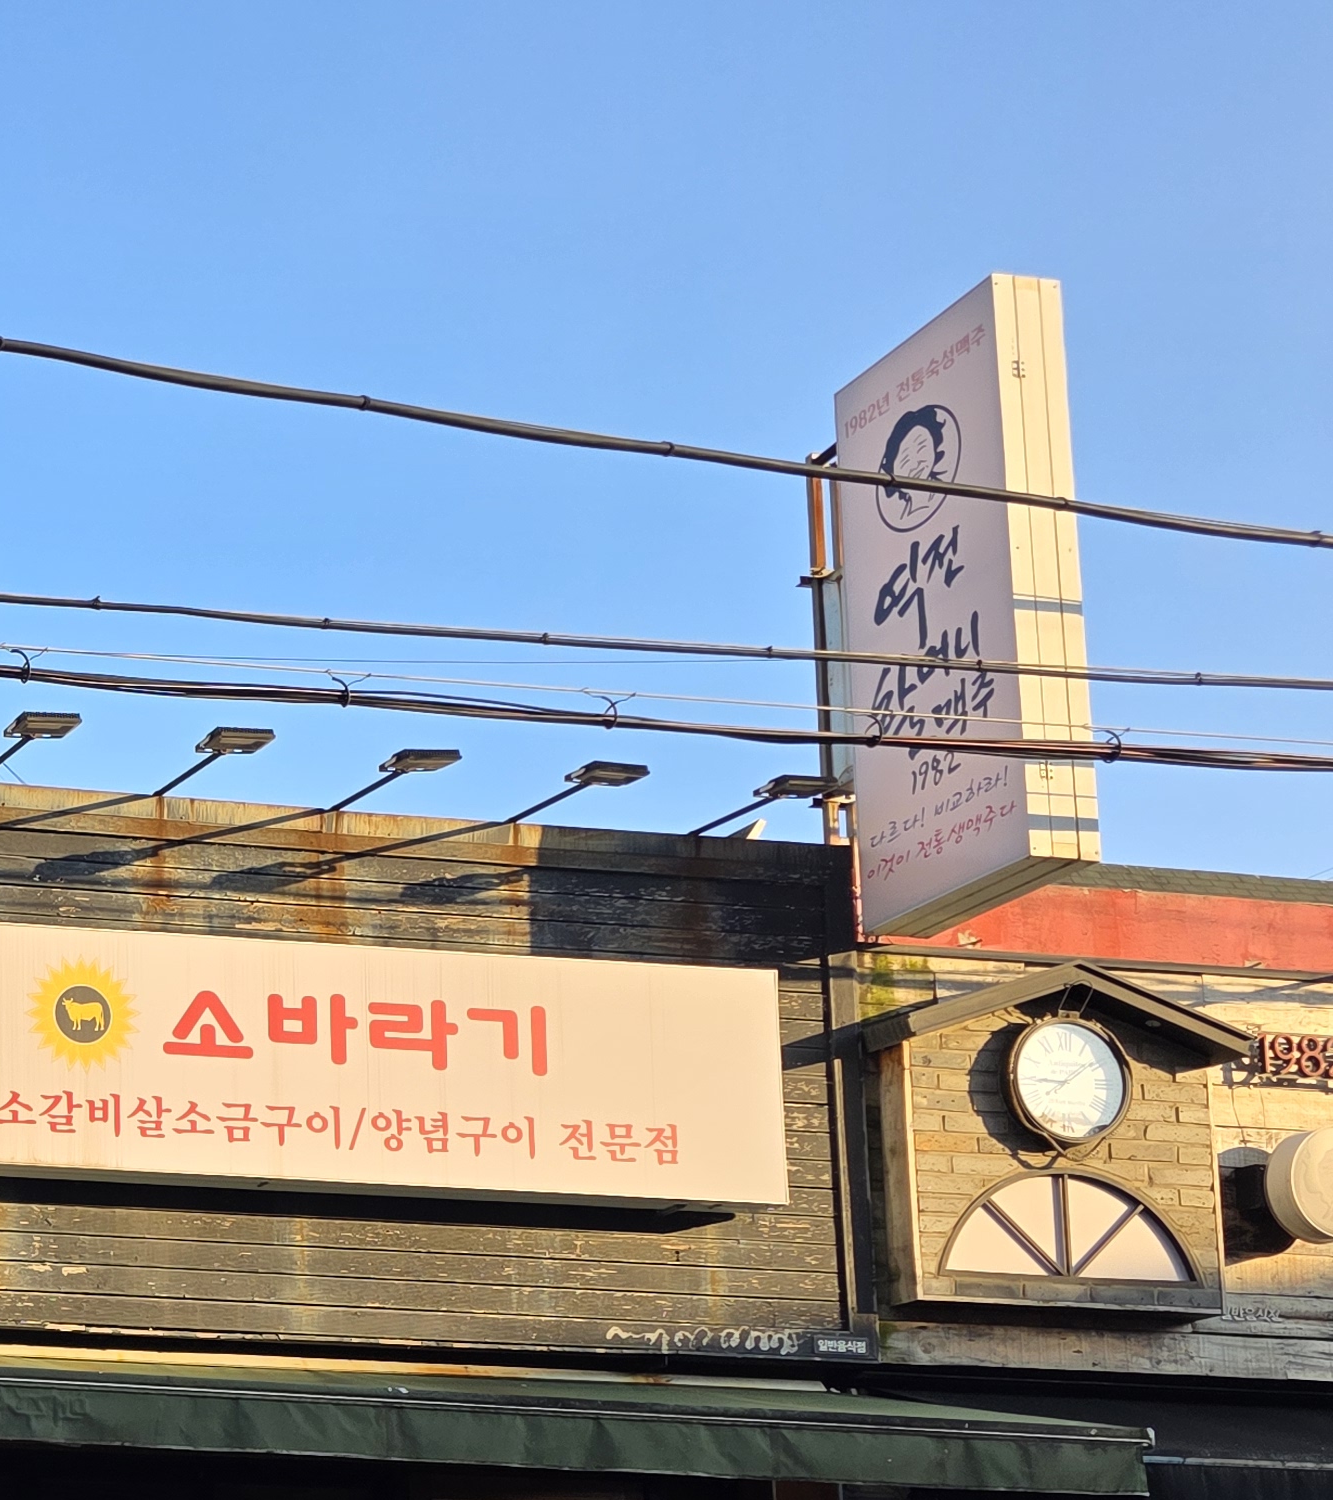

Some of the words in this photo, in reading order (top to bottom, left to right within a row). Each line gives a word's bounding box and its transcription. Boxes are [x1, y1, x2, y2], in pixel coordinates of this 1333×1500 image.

[843, 391, 890, 439] 1982년
[873, 526, 964, 650] 역전
[912, 751, 961, 795] 1982
[162, 989, 550, 1077] 소바라기
[557, 1121, 682, 1167] 전문점
[816, 1339, 867, 1354] 일반음식점
